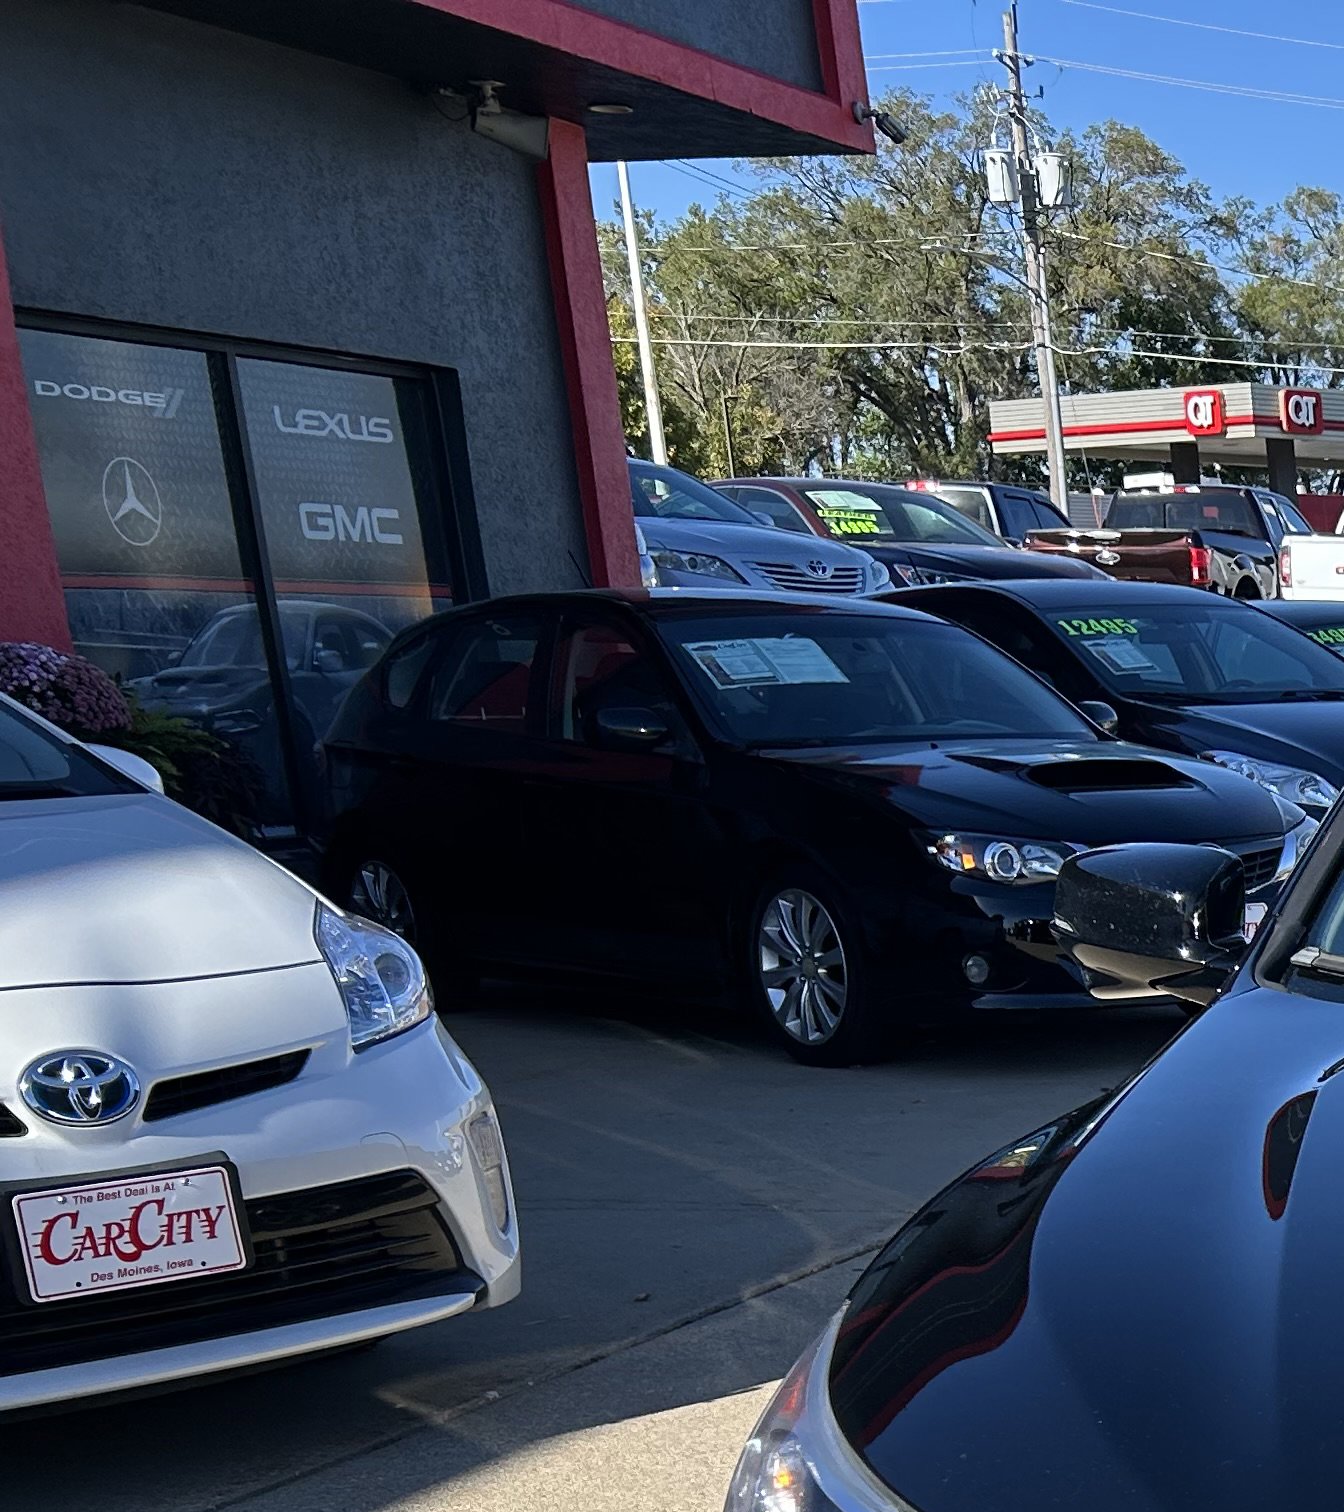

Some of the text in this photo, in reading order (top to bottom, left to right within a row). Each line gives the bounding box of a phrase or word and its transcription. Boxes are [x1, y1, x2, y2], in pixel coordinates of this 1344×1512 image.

[34, 379, 166, 408] DODGE
[273, 405, 393, 443] LEXUS
[1187, 395, 1214, 429] QT
[1288, 394, 1316, 427] QT
[299, 502, 403, 544] GMC
[1057, 618, 1138, 636] 12495
[72, 1182, 176, 1206] The Best Deal Is At
[90, 1271, 114, 1282] Des
[166, 1258, 194, 1270] Iowa
